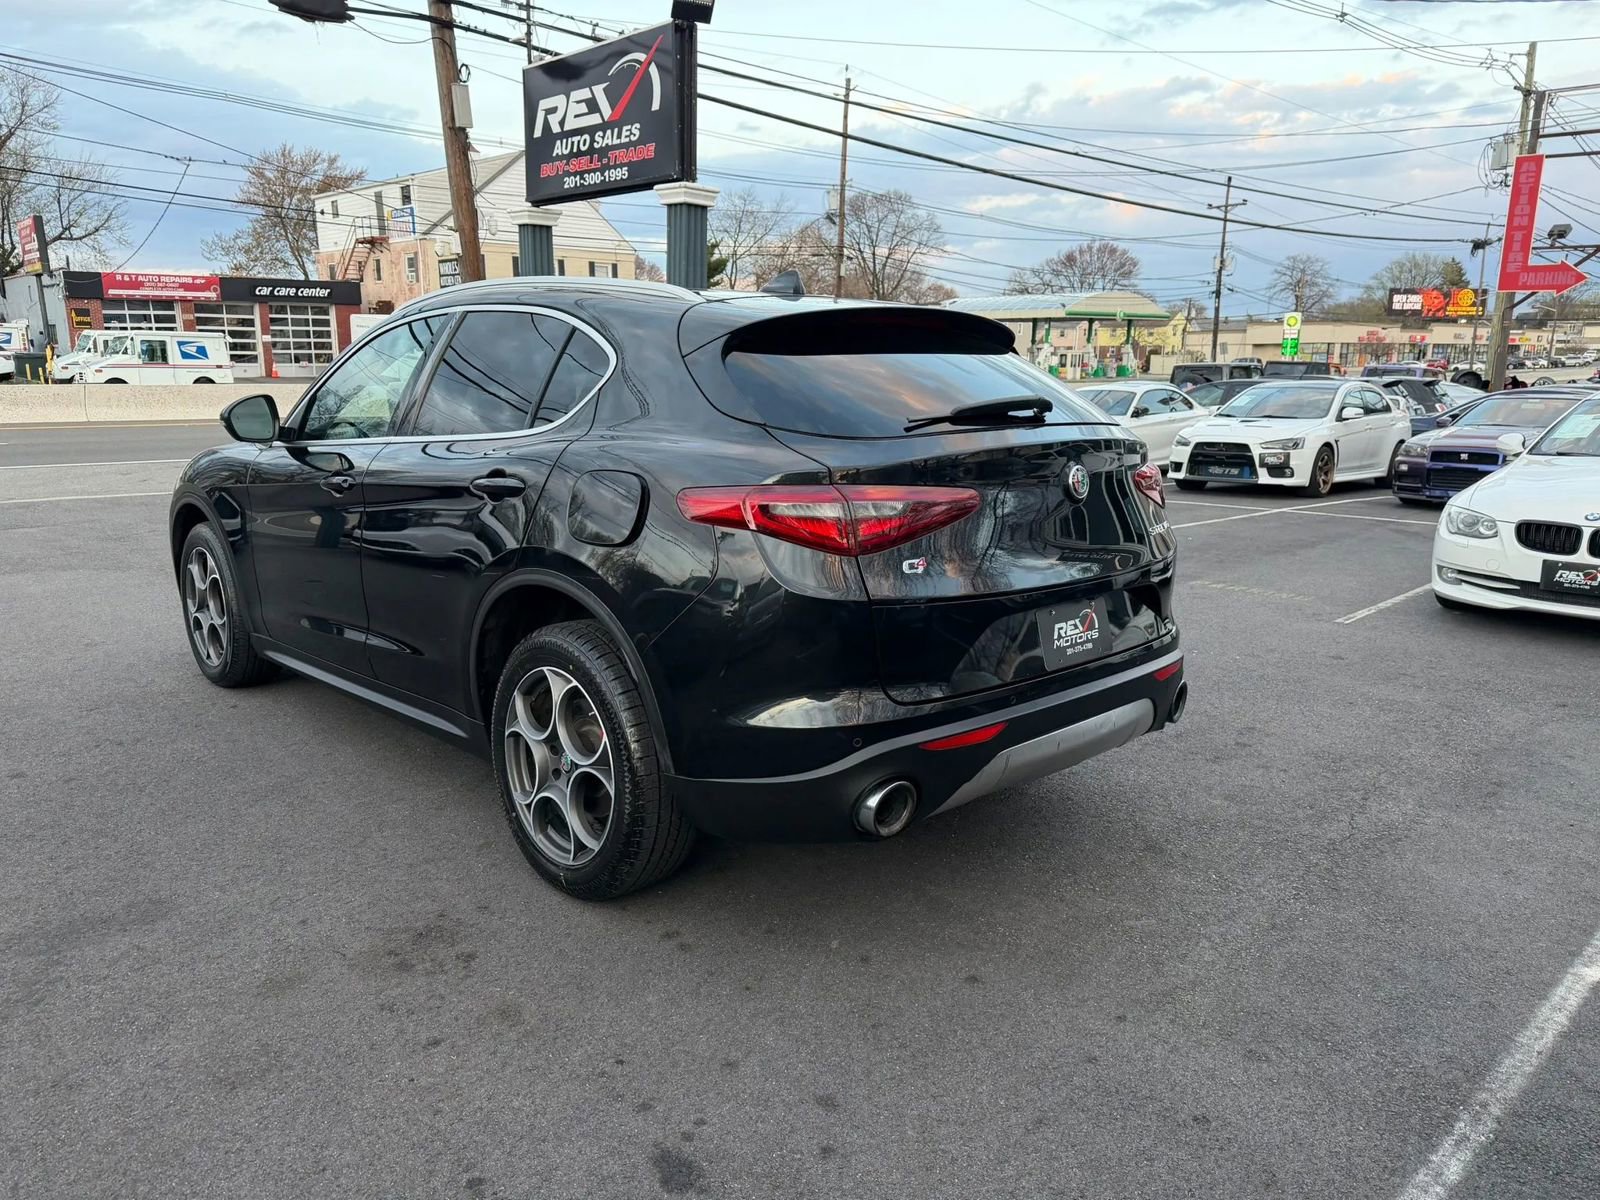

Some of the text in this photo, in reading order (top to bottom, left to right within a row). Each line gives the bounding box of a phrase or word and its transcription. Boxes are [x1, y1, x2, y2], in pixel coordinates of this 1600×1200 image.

[552, 123, 641, 157] AUTO SALES
[563, 167, 629, 189] 201-300-1995
[1506, 161, 1537, 273] ACTION TIRE
[138, 275, 159, 283] AUTO
[160, 276, 193, 284] REPAIRS
[1518, 271, 1577, 286] PARKING
[255, 286, 331, 297] car care center
[1053, 629, 1099, 649] MOTORS
